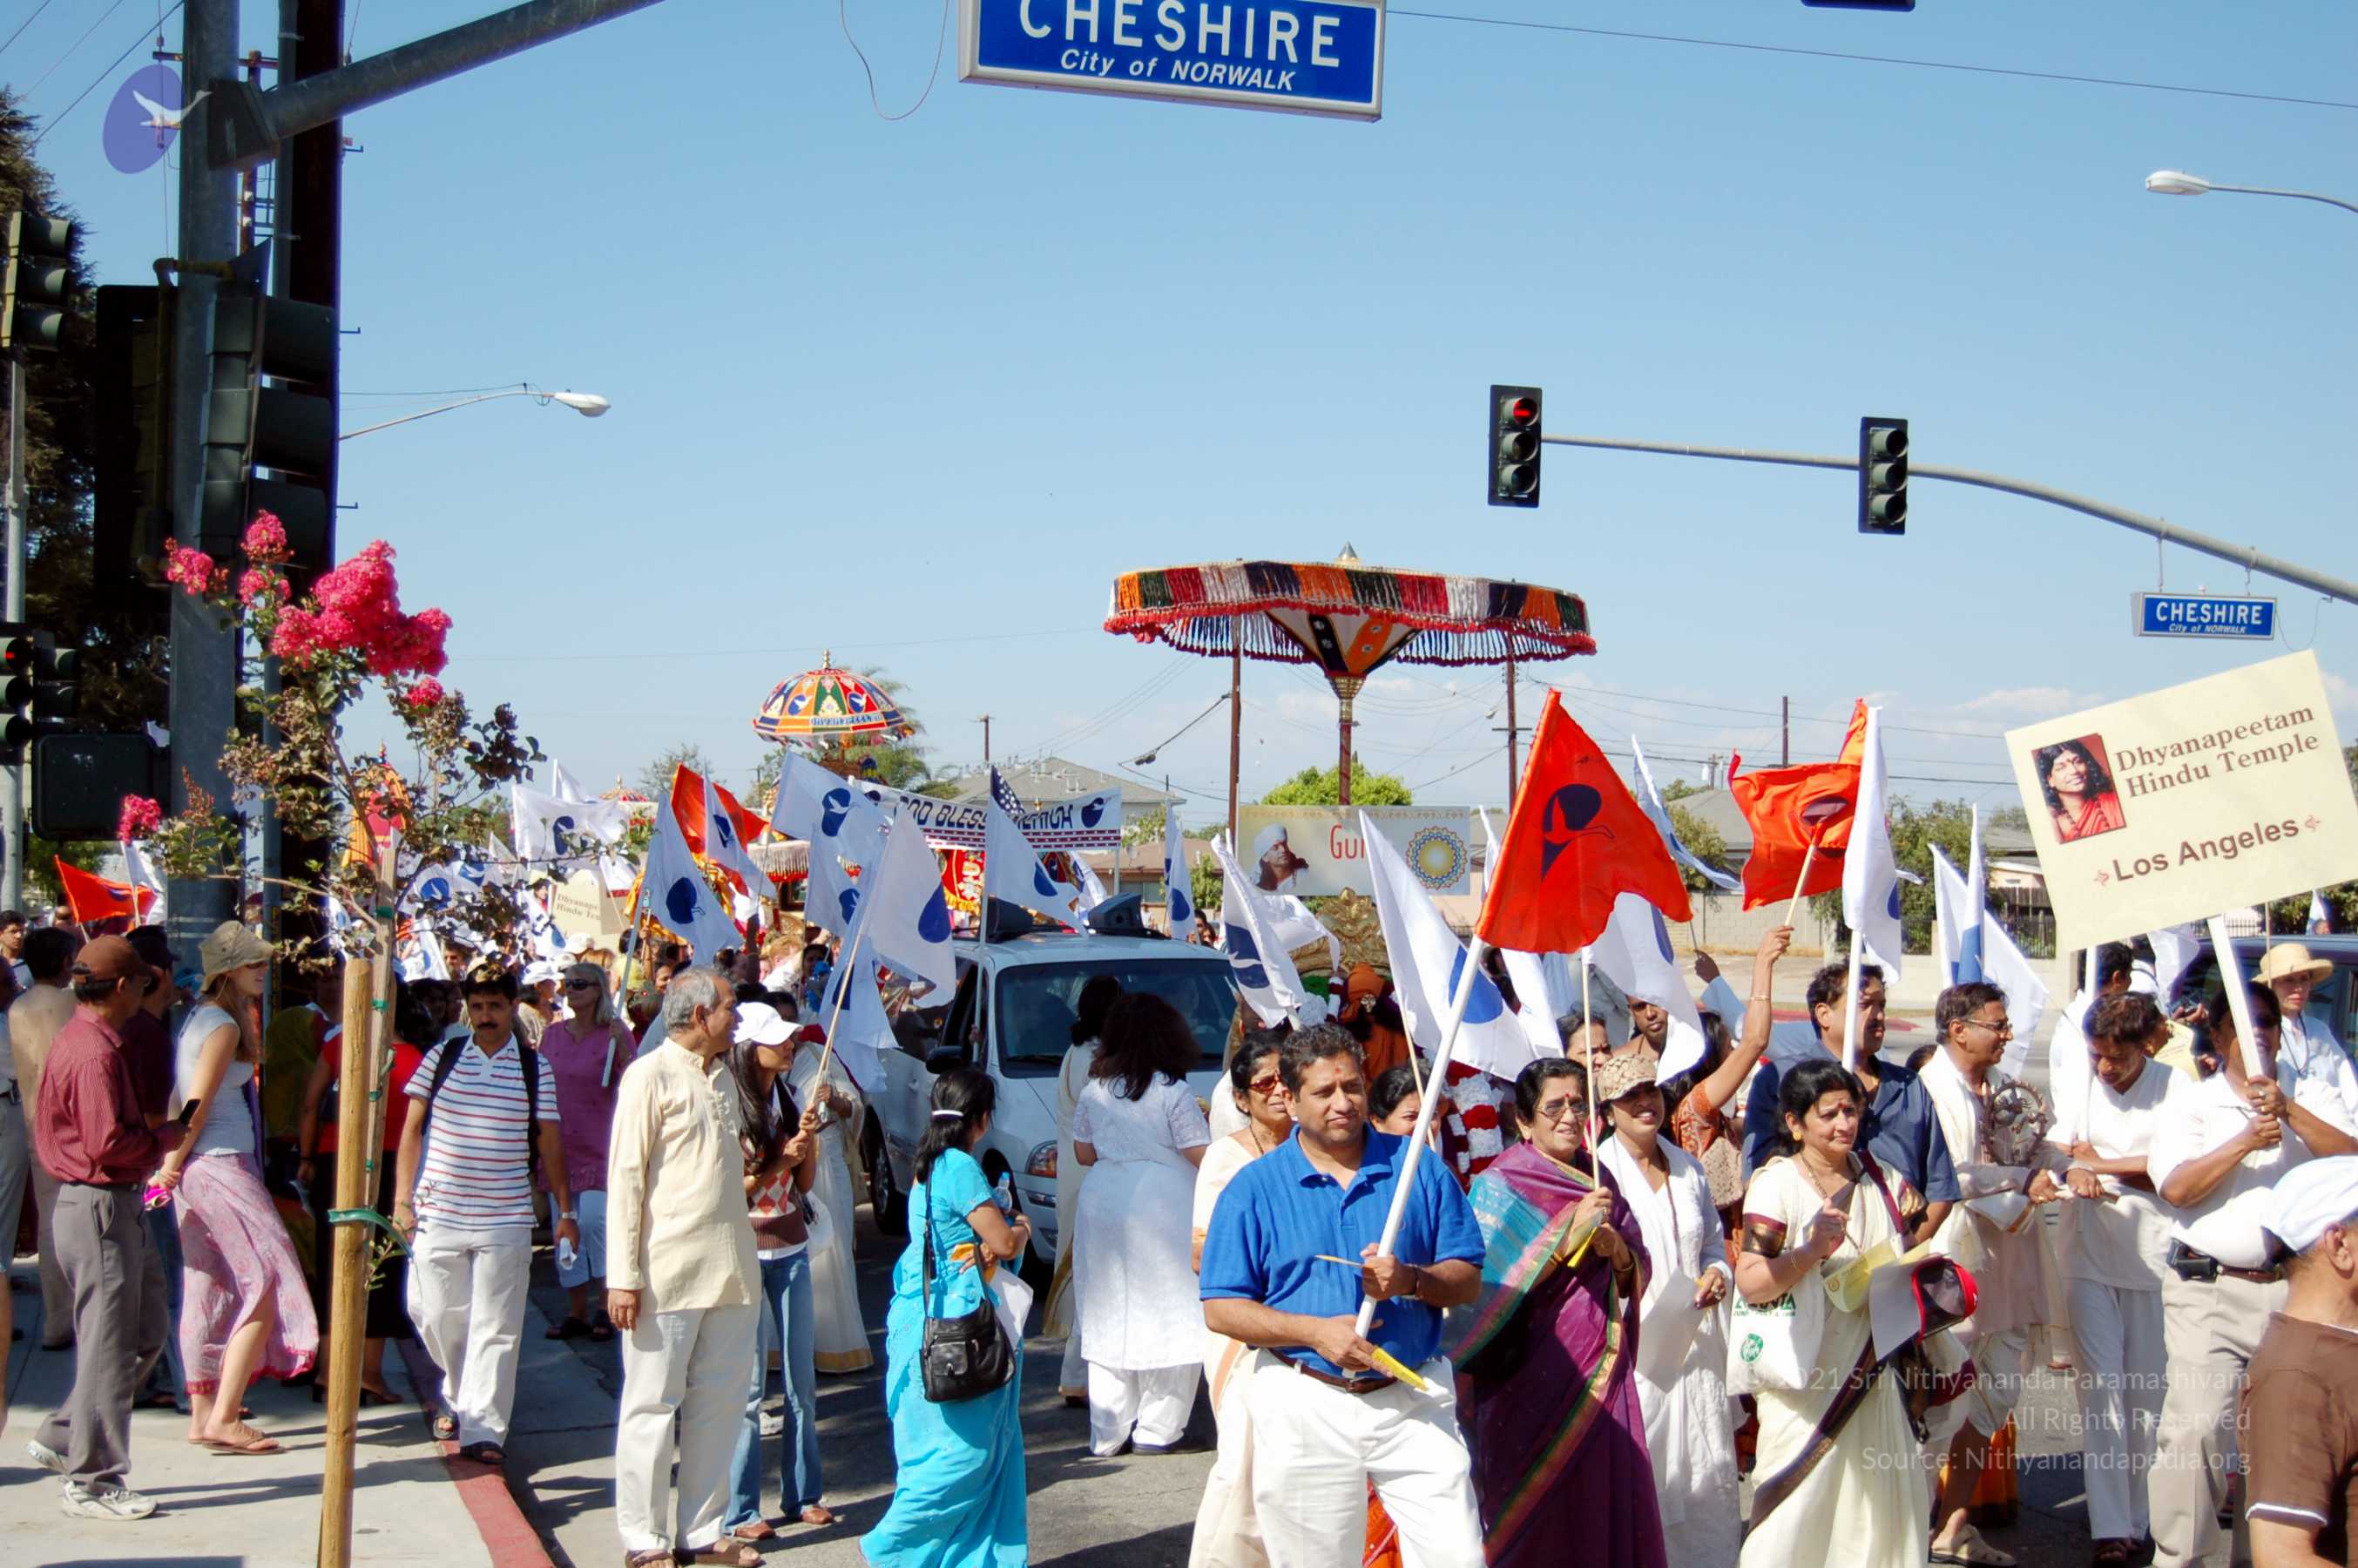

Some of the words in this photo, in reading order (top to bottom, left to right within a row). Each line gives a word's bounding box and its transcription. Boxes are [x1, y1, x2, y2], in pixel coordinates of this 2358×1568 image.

[1020, 0, 1340, 67] CHESHIRE
[1060, 49, 1115, 76] City
[1130, 59, 1157, 78] of
[1171, 60, 1296, 91] NORWALK
[2156, 601, 2263, 625] CHESHIRE
[2169, 623, 2187, 633] City
[2191, 625, 2200, 633] of
[2204, 625, 2247, 635] NORWALK
[2115, 706, 2314, 772] Dhyanapeetam
[2125, 764, 2211, 798] Hindu
[2217, 734, 2320, 772] Temple
[2112, 853, 2169, 882] Los
[2179, 818, 2300, 865] Angeles
